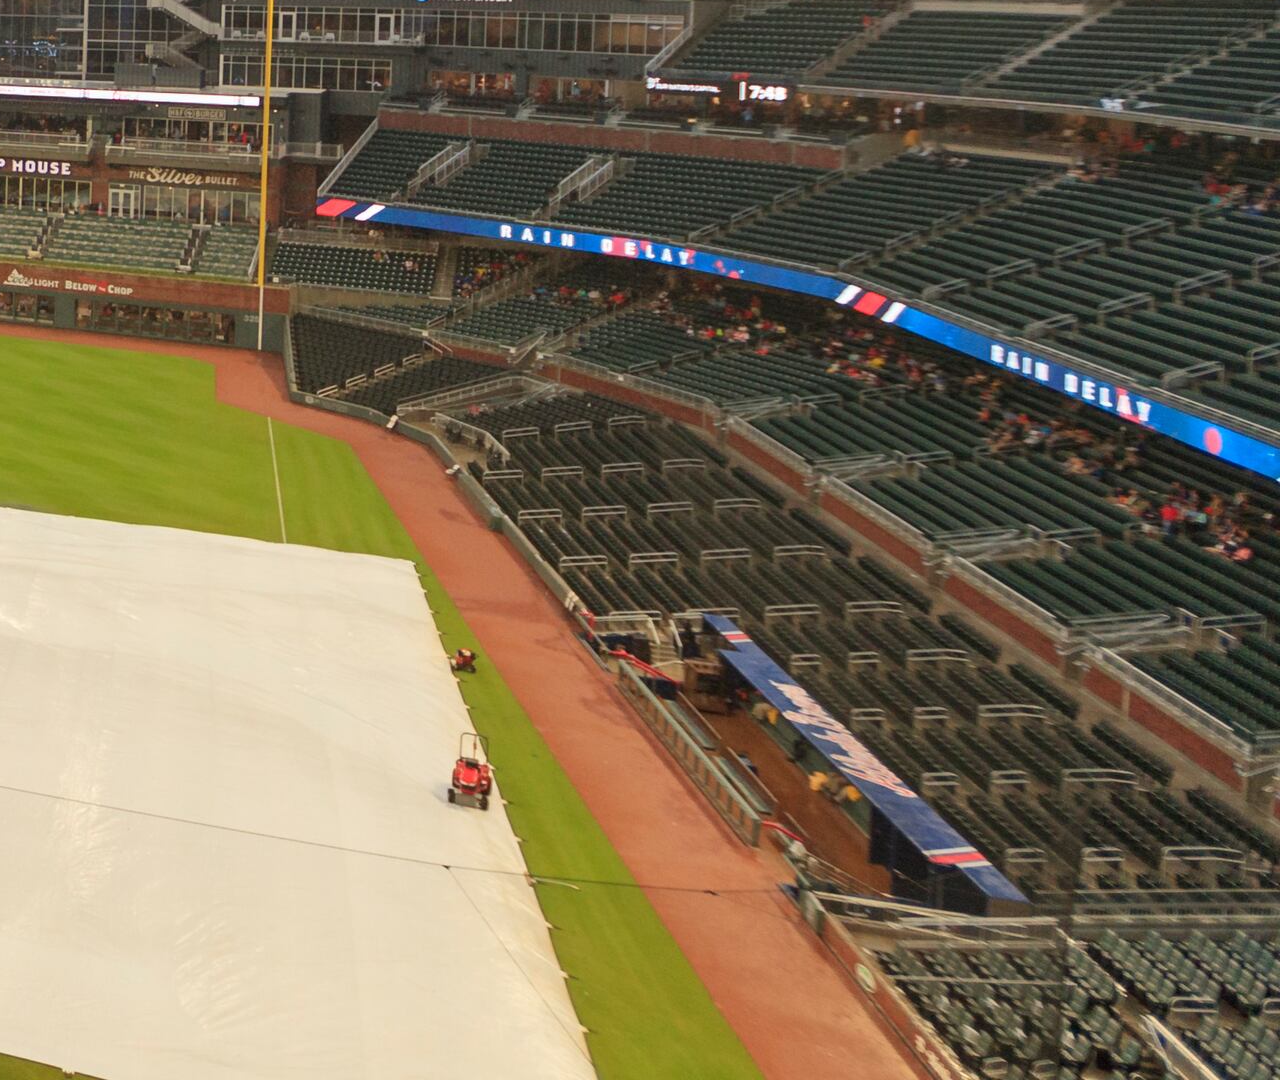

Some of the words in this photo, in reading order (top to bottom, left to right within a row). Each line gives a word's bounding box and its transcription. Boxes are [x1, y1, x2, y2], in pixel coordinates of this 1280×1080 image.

[11, 159, 72, 176] HOUSE
[128, 170, 146, 180] THE
[146, 167, 204, 186] Silver
[499, 224, 574, 248] RAIN
[600, 237, 690, 266] DELAY
[34, 278, 59, 289] LIGHT
[990, 344, 1050, 382] RAIN
[1063, 373, 1152, 422] DELAY
